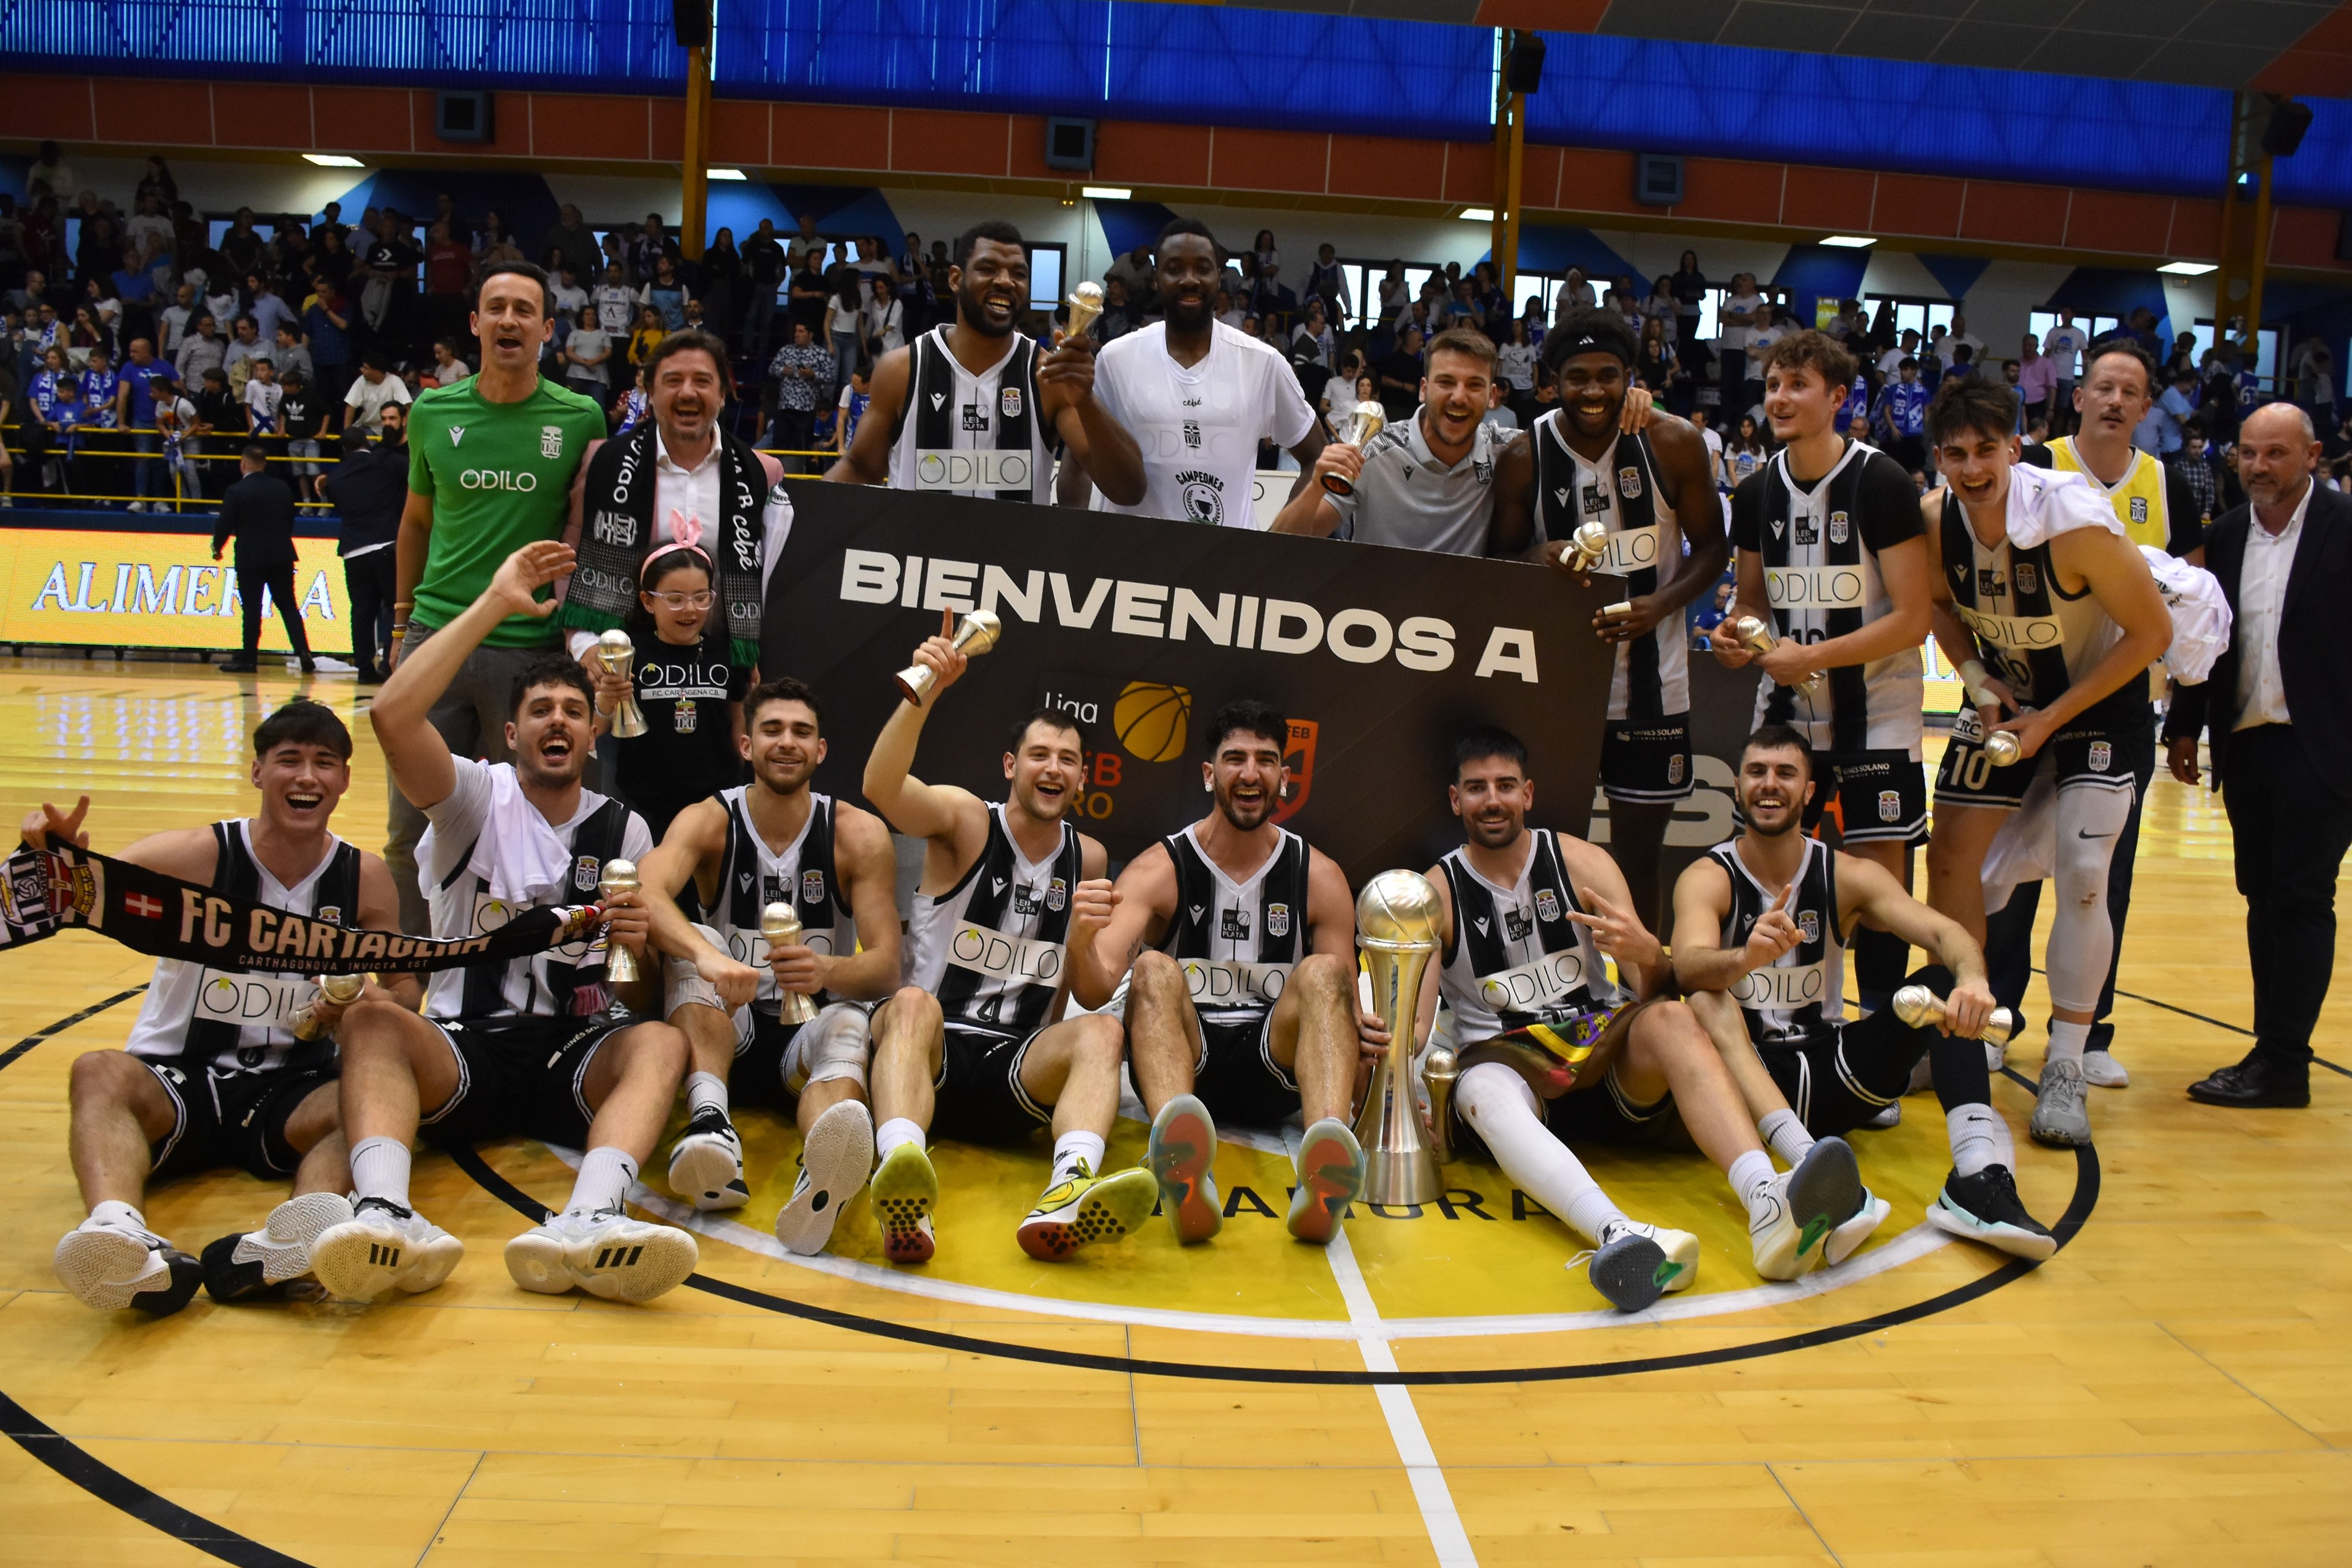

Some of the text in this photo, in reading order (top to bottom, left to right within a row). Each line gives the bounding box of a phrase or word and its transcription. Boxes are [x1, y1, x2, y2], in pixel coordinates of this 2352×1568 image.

[1182, 397, 1202, 408] cebé
[461, 469, 537, 492] ODILO
[919, 455, 1027, 485] ODILO
[1175, 470, 1224, 492] CAMPEONES
[1589, 533, 1655, 571] ILO
[33, 560, 336, 620] ALIMEA
[1768, 571, 1861, 602] ODILO
[840, 549, 1538, 683] BIENVENIDOS A
[639, 663, 729, 686] ODILO
[1657, 727, 1684, 736] SOLANO
[1859, 762, 1890, 773] SOLANO
[1950, 745, 1991, 791] 10
[1071, 791, 1114, 820] RO
[180, 888, 232, 948] FC
[1015, 905, 1036, 913] PLATA
[1223, 923, 1239, 931] LEB
[1223, 931, 1244, 939] PLATA
[239, 955, 428, 971] CARTHAGONOVA INVICTA EST
[729, 933, 833, 968] ODO
[953, 930, 1059, 979] ODILO
[1183, 966, 1286, 1000] ODILO
[1482, 955, 1581, 1009] ODILO
[1728, 969, 1822, 1003] ODILO
[203, 978, 322, 1020] ODI
[976, 994, 1005, 1023] 4
